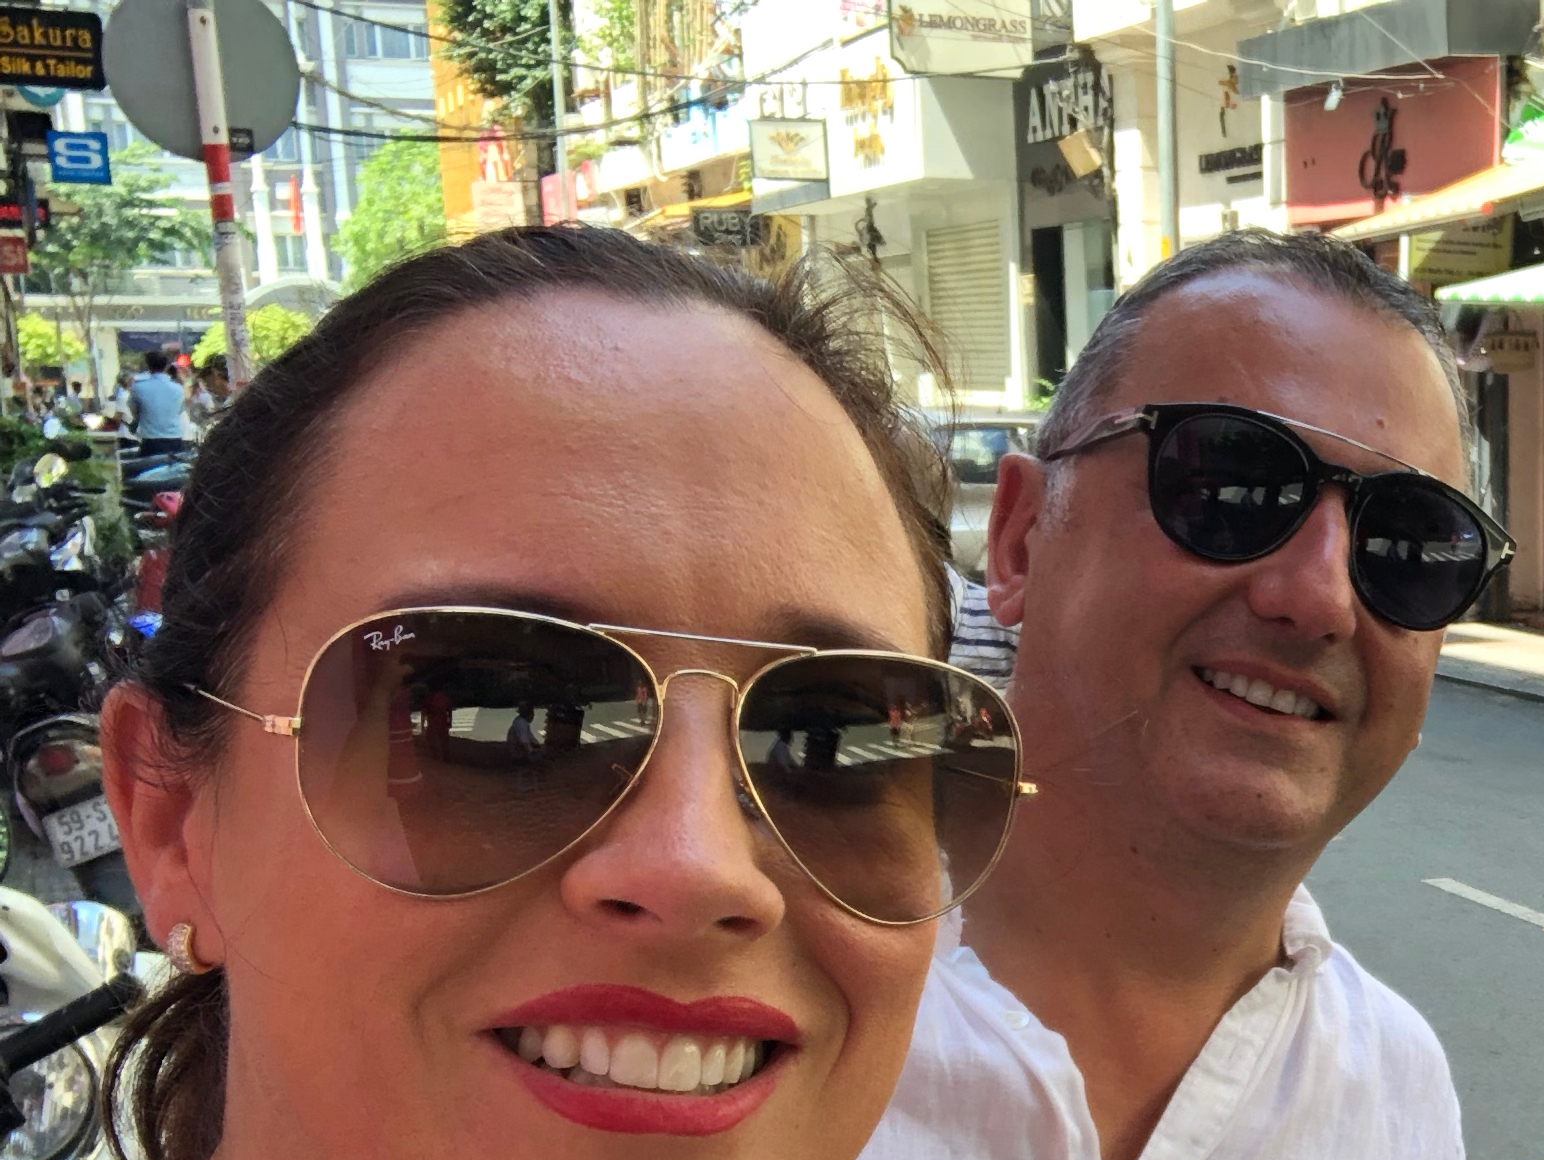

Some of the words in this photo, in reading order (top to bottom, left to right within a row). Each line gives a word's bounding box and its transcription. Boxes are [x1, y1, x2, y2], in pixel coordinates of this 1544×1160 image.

[0, 15, 92, 48] Sakura
[918, 13, 1027, 35] LEMONGRASS
[0, 55, 31, 75] Silk
[35, 59, 45, 76] &
[46, 58, 94, 79] Tailor
[700, 212, 754, 239] RUBY
[363, 625, 415, 651] Ray-Ban
